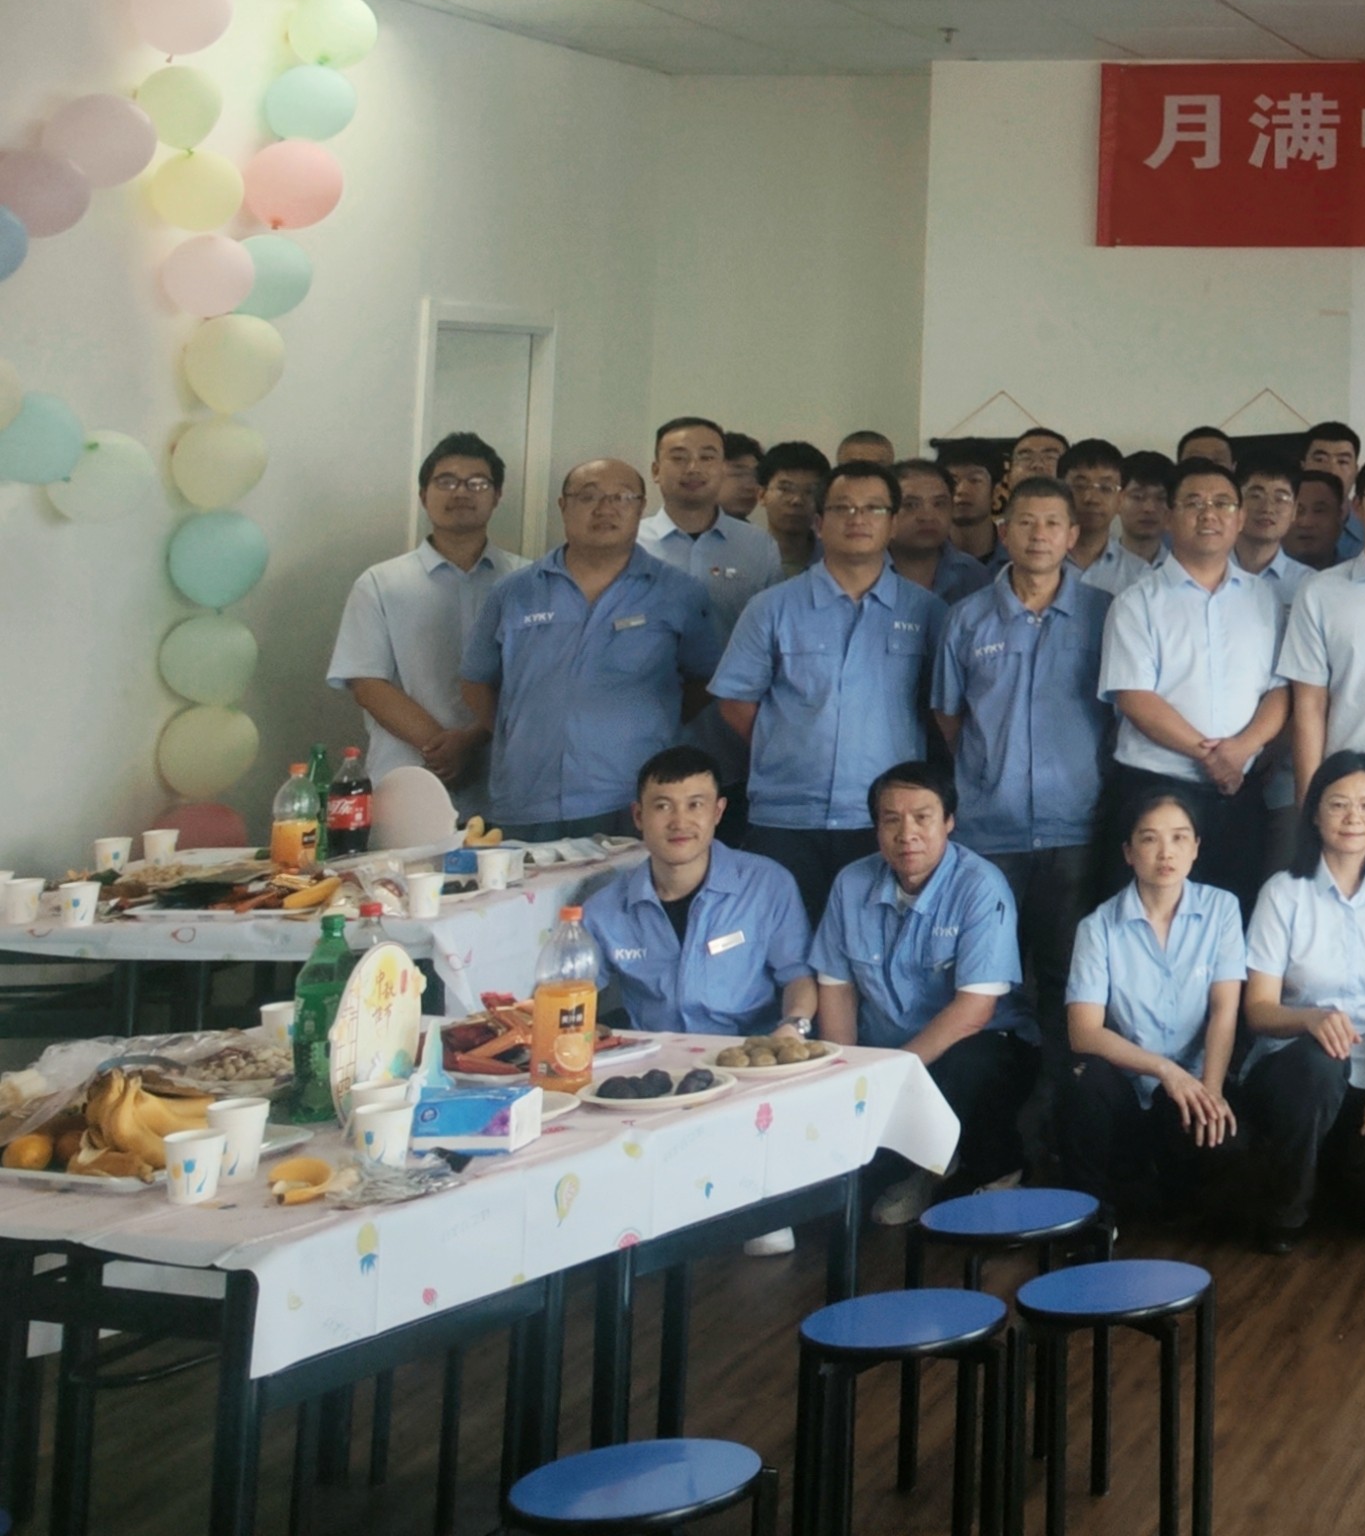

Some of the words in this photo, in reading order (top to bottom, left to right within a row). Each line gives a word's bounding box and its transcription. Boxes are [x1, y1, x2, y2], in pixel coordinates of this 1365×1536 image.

[524, 611, 555, 624] KYKY
[894, 621, 920, 632] KYKY
[974, 642, 1005, 656] KYKY
[615, 948, 647, 960] KYKY
